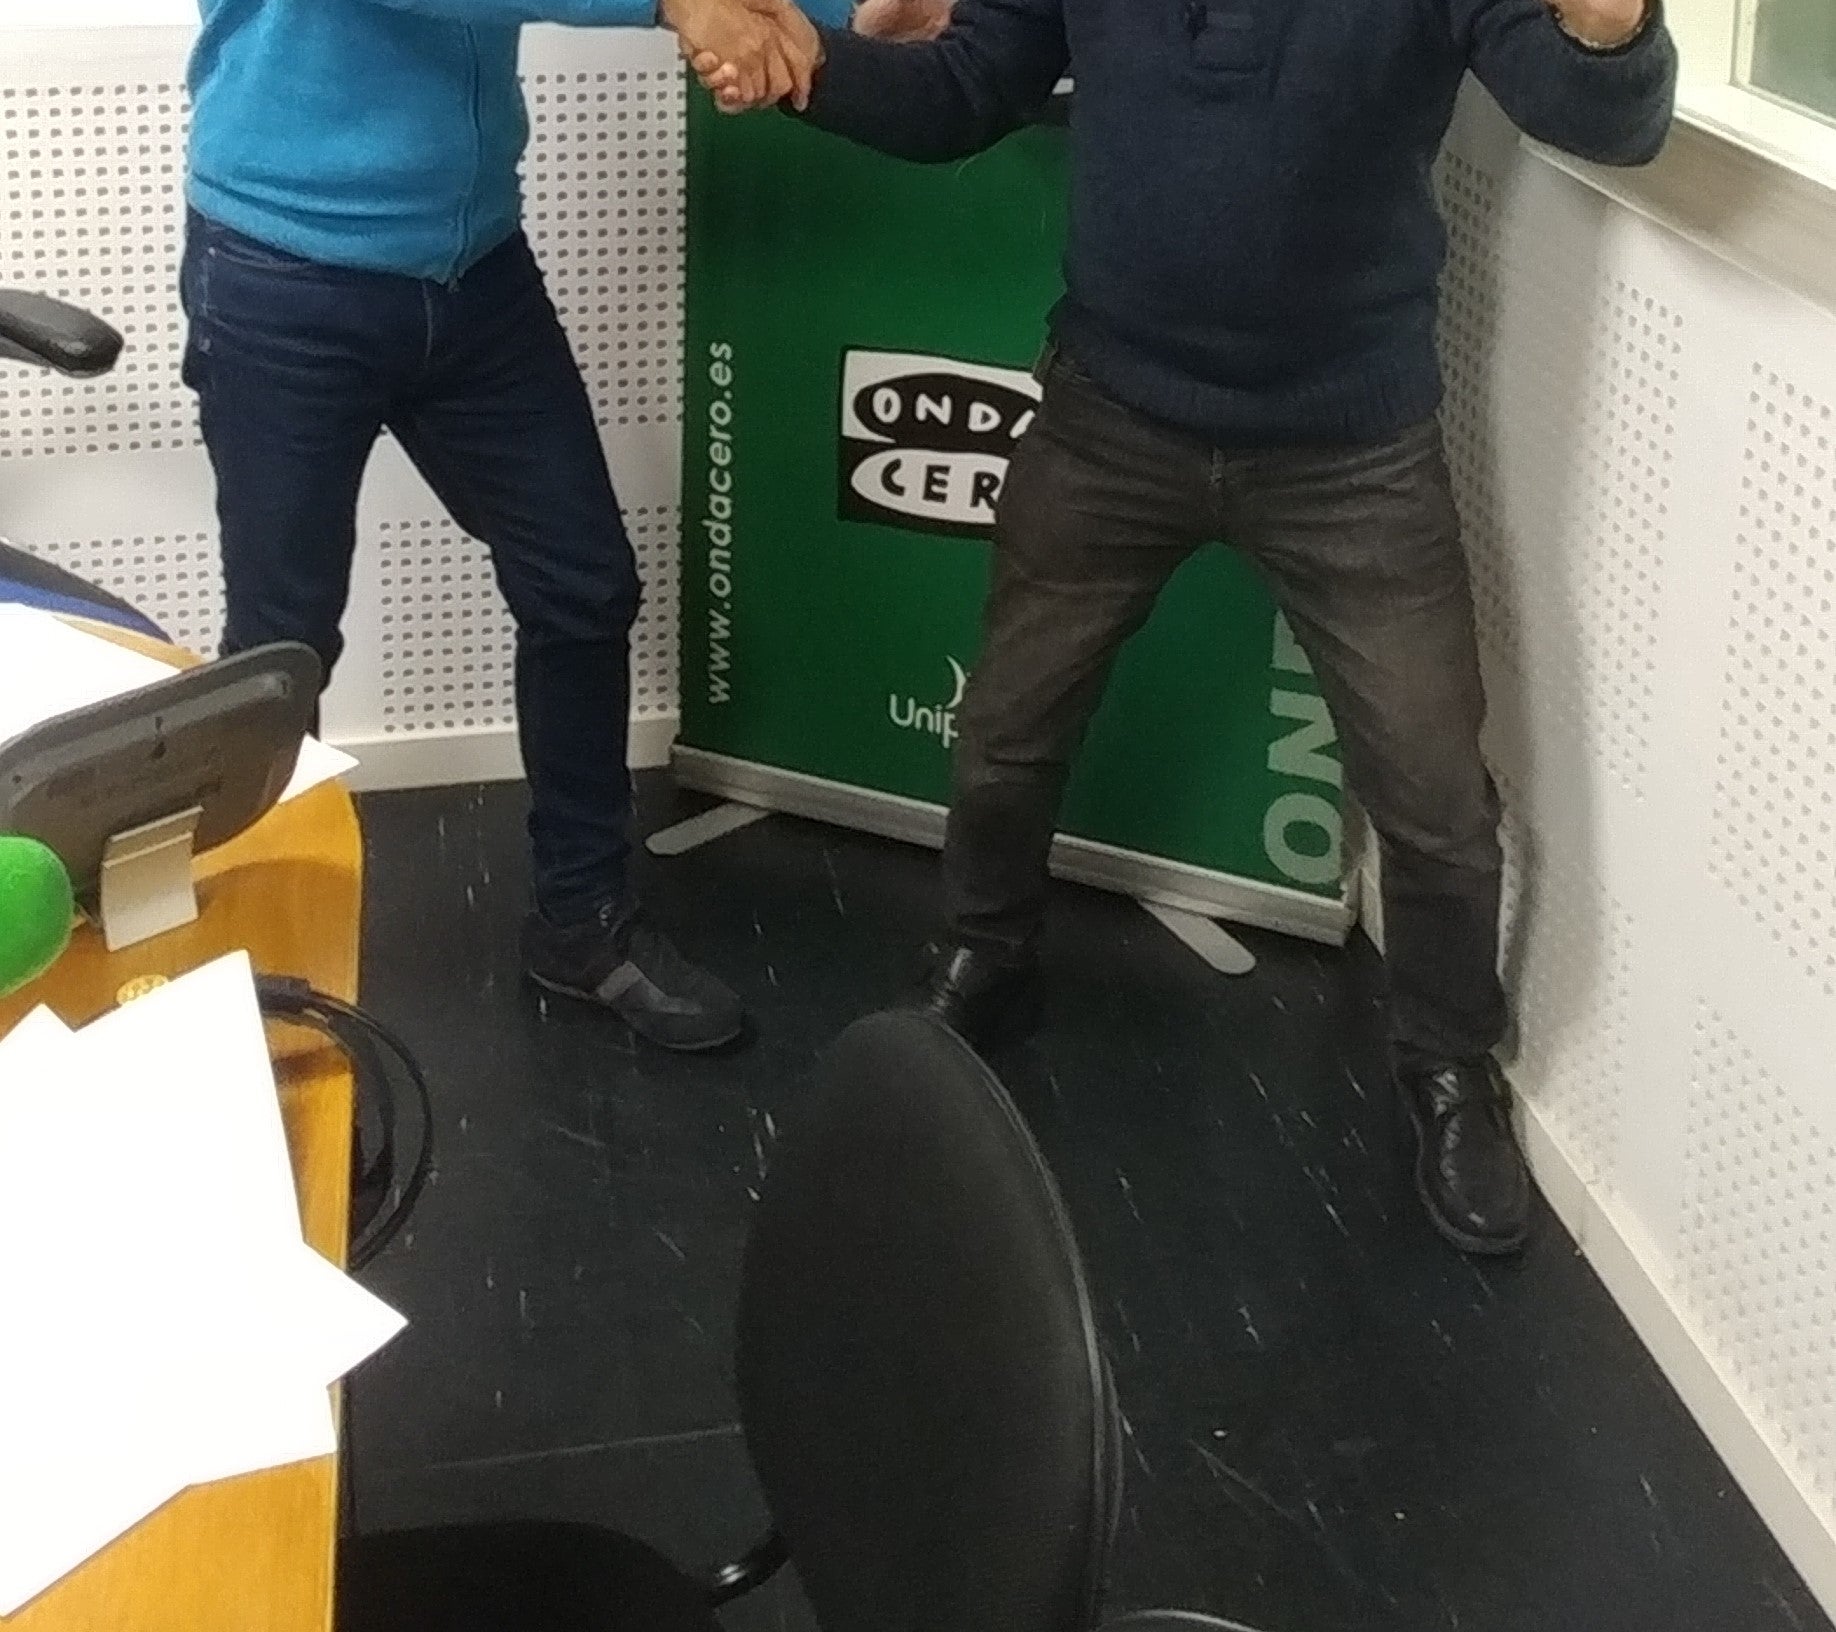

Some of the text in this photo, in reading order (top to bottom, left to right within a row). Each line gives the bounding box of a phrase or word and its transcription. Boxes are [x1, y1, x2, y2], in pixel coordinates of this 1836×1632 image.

[701, 342, 732, 704] www.ondacero.es
[880, 458, 1002, 514] CER
[889, 693, 959, 749] Unip
[1263, 608, 1344, 884] ON
